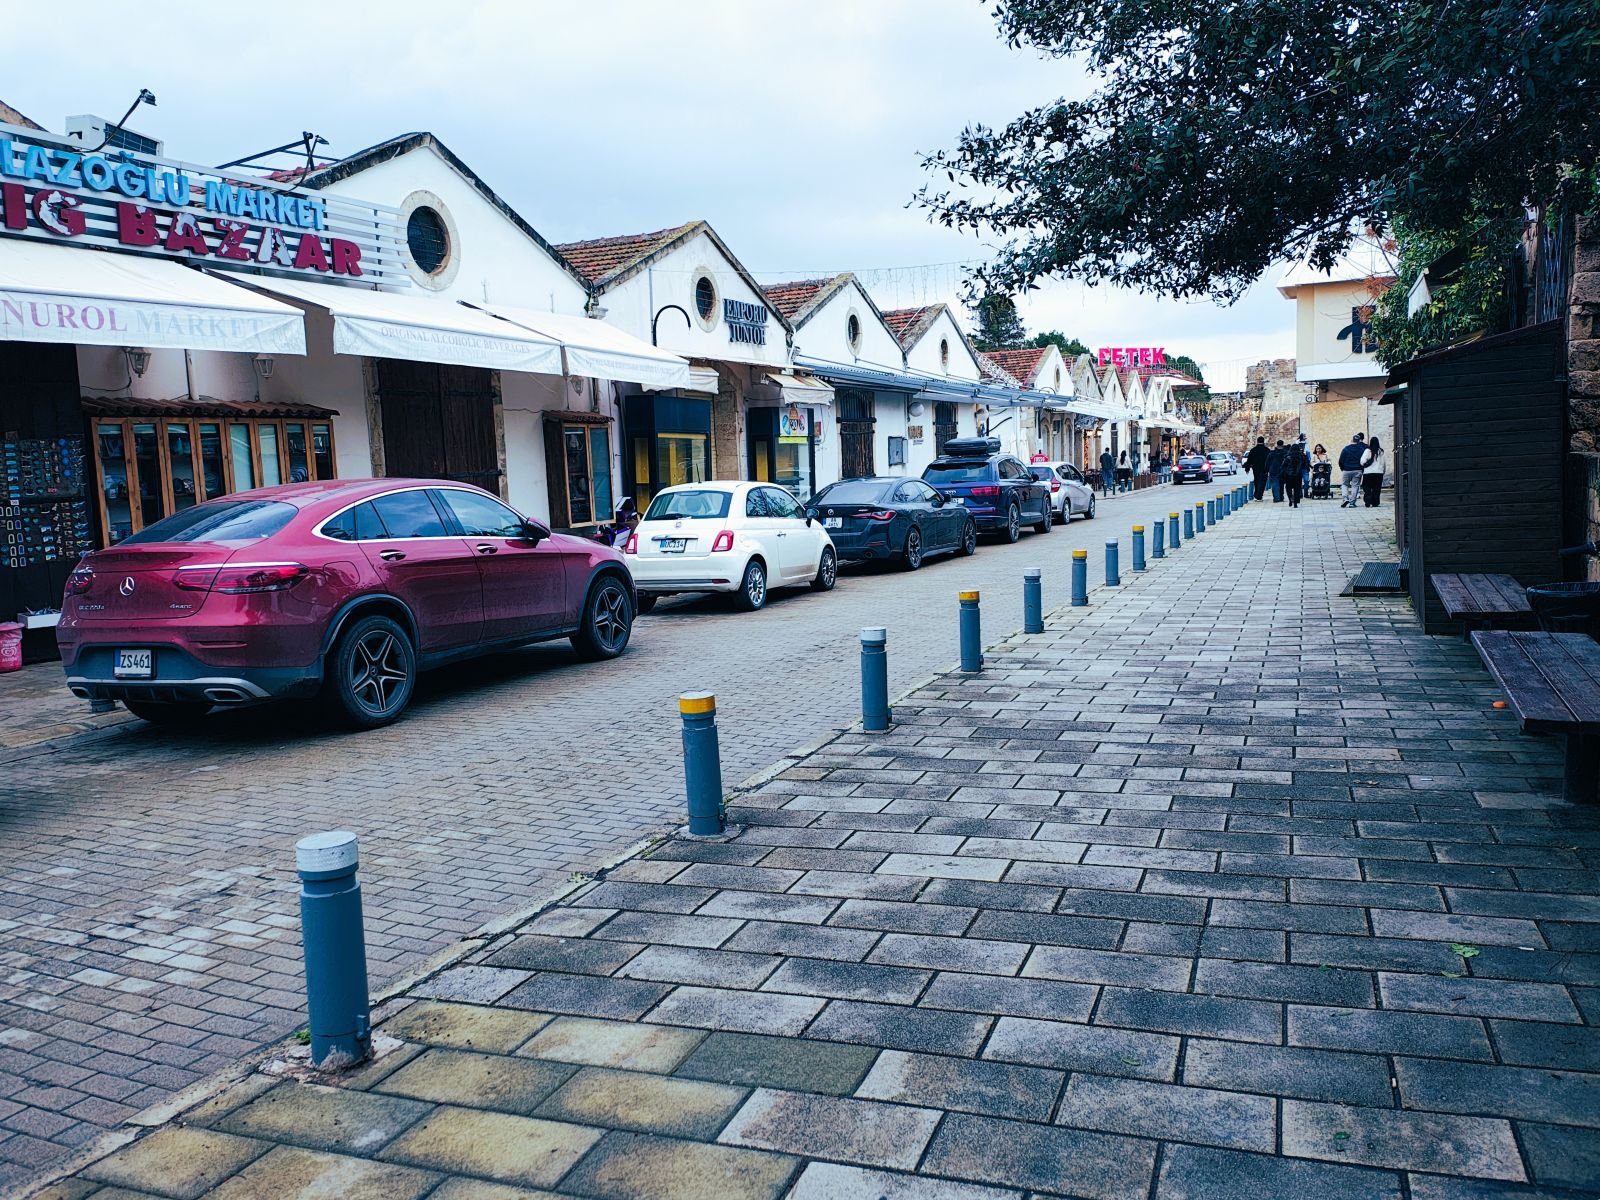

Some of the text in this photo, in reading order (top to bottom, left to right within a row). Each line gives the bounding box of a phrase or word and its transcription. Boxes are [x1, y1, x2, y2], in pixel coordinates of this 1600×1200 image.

[206, 181, 325, 230] MARKET
[117, 201, 363, 276] BAZAAR
[2, 299, 127, 332] NUROL
[136, 309, 264, 338] MARKET
[723, 299, 767, 323] EMPORIO
[381, 326, 530, 353] ORIGINAL ALCOHOLIC BEVERAGES
[729, 322, 767, 345] JUNIOR
[120, 654, 151, 668] ZS461
